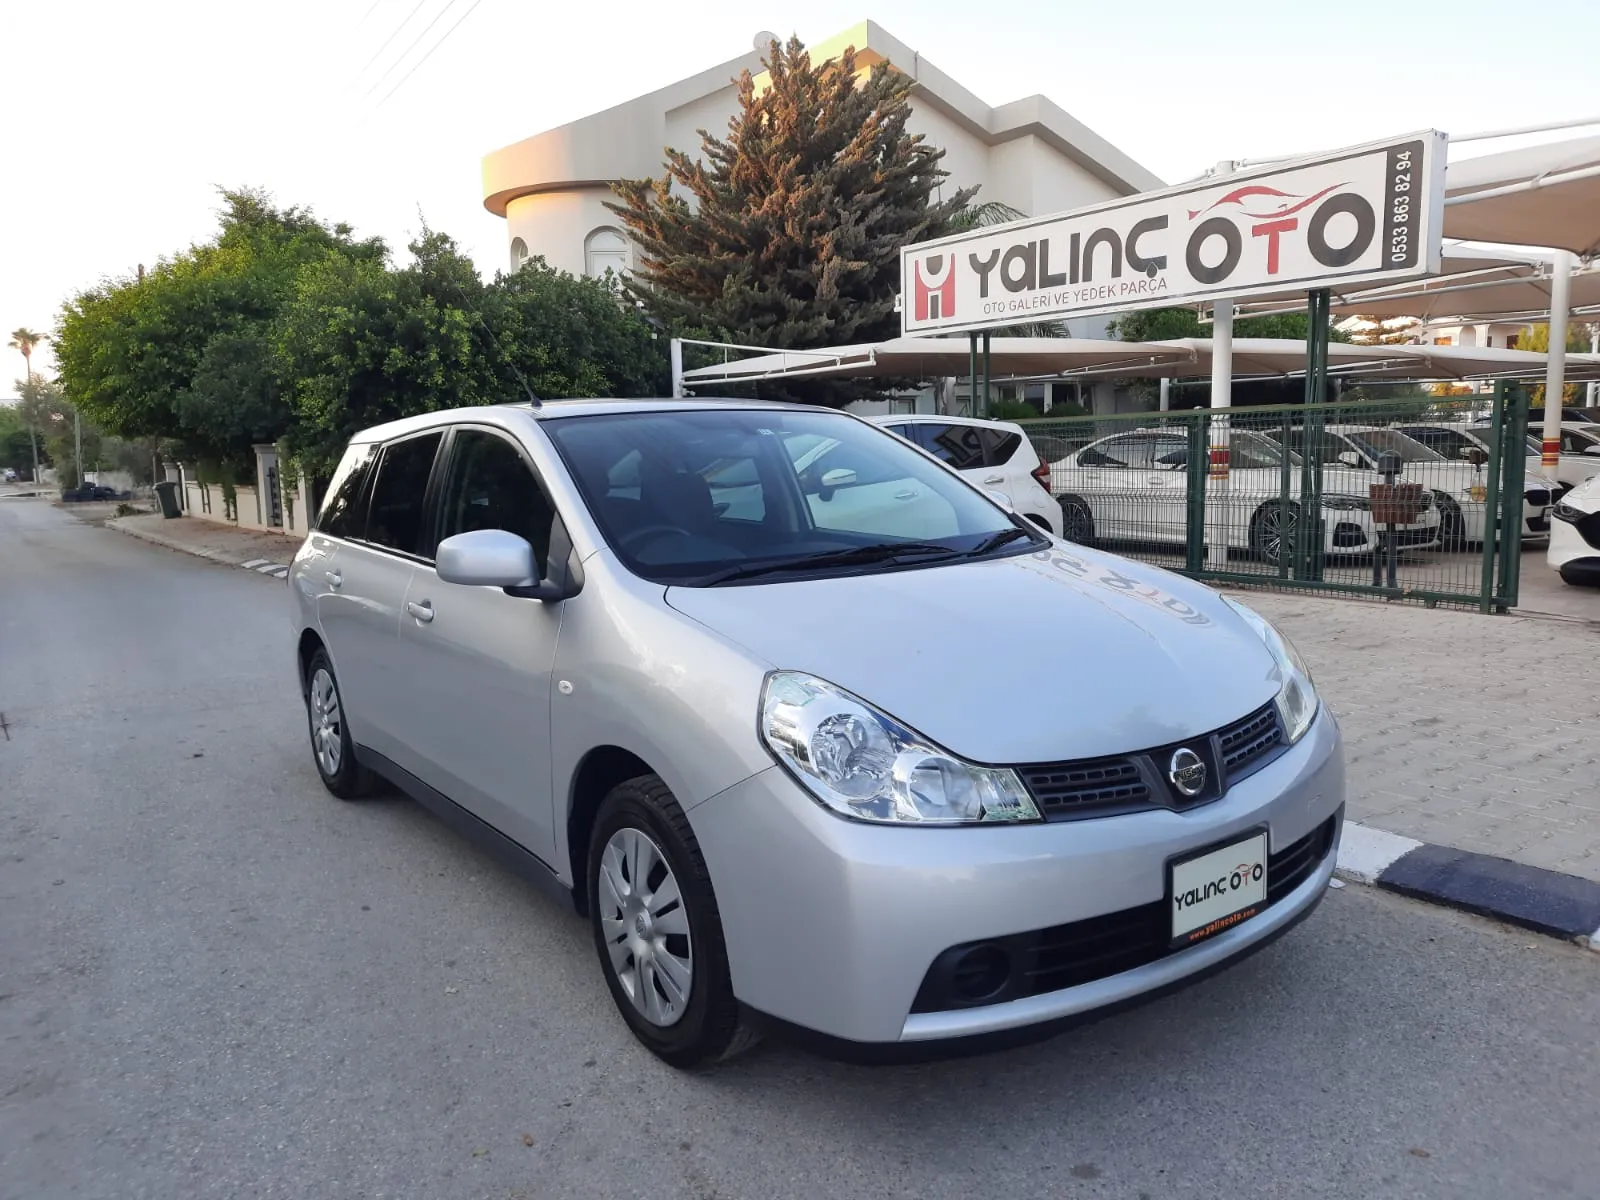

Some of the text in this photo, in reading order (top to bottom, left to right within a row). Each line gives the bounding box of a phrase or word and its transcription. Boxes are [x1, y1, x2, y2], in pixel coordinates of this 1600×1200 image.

[1185, 192, 1376, 285] OTO
[1391, 150, 1412, 262] 0533 863 82 94
[983, 277, 1168, 315] OTO GALERİ VE YEDEK PARÇA
[1230, 863, 1264, 891] OTO
